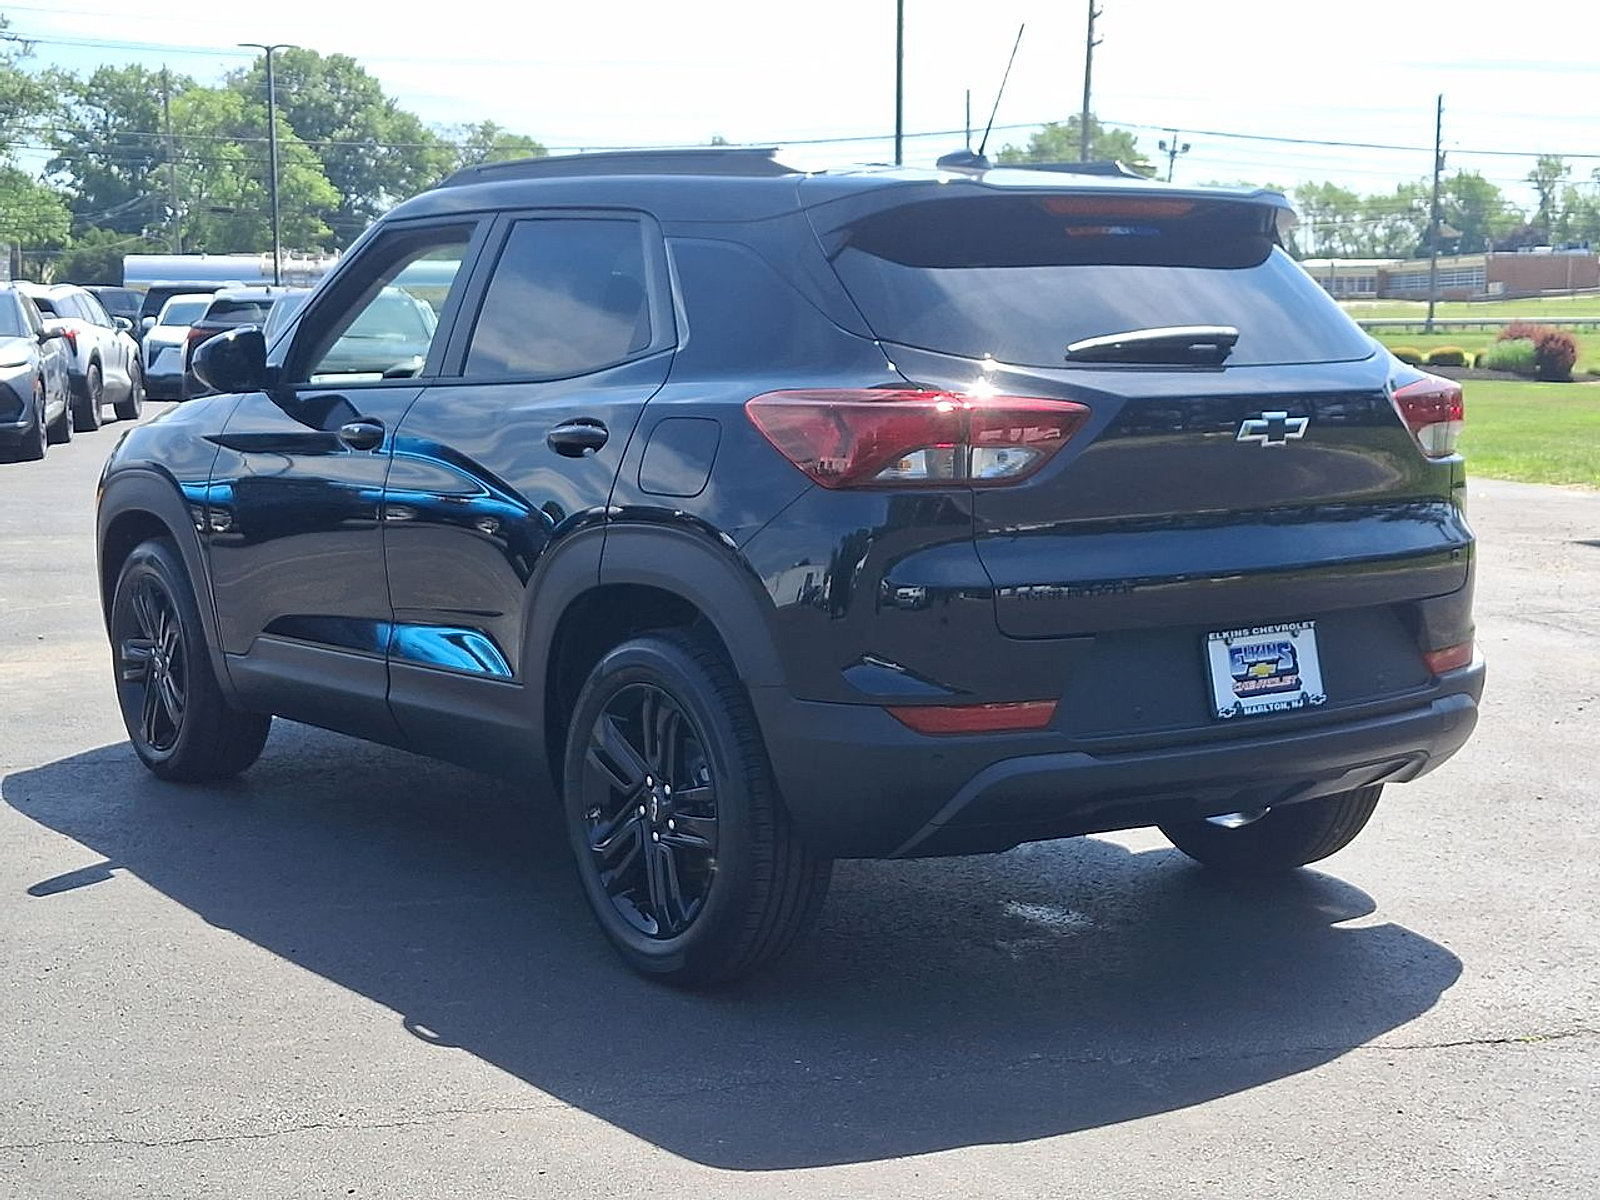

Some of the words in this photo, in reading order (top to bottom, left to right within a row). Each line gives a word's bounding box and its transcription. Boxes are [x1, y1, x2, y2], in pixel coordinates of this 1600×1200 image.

[1208, 628, 1250, 640] ELKINS
[1252, 621, 1316, 635] CHEVROLET
[1291, 700, 1304, 710] NJ
